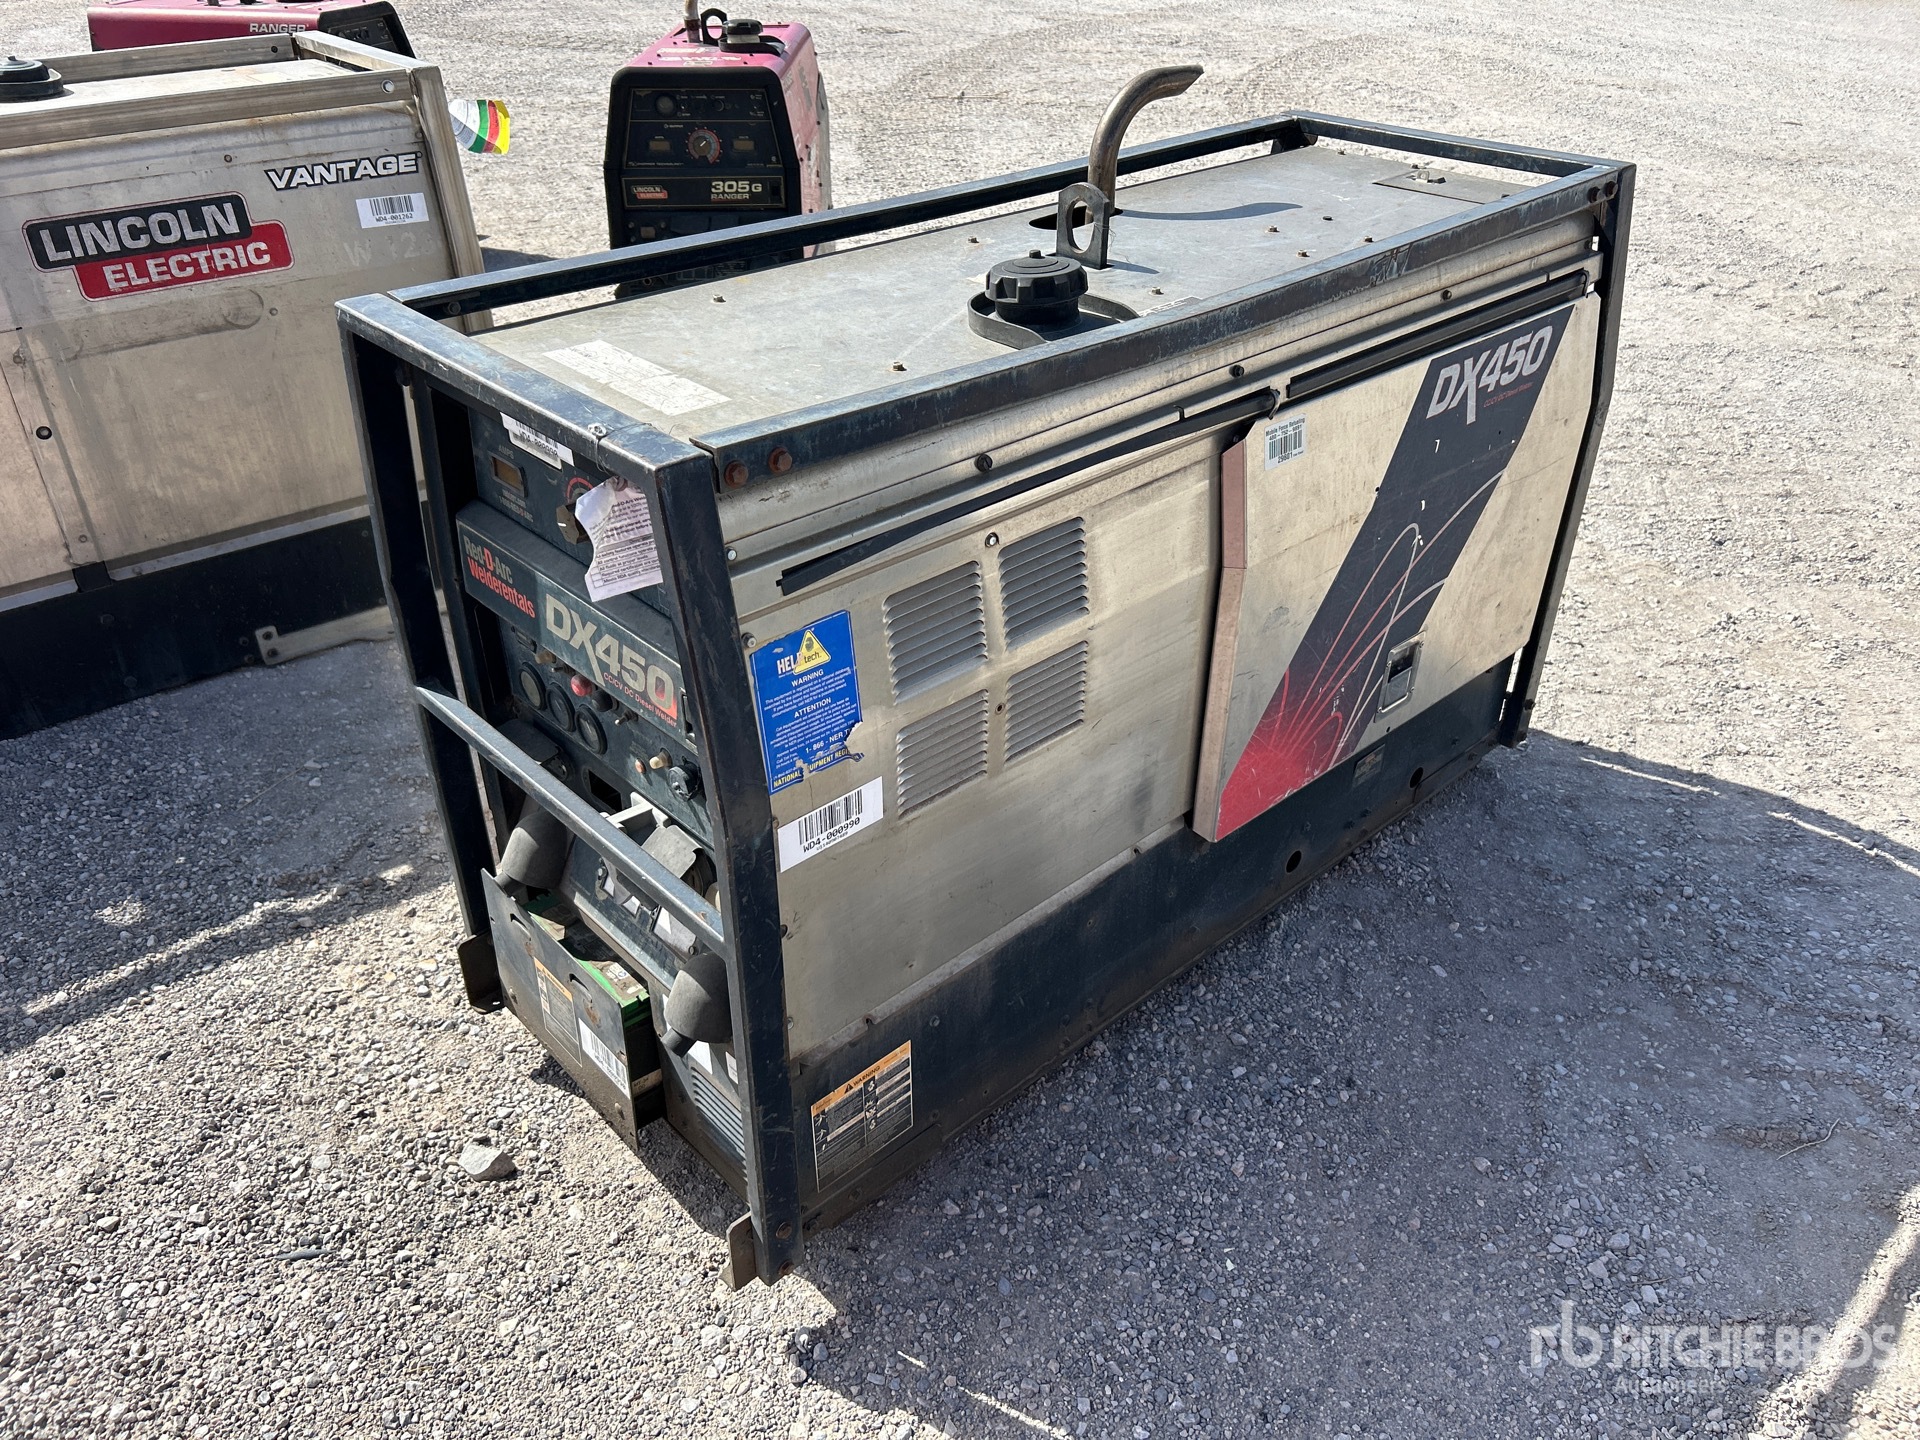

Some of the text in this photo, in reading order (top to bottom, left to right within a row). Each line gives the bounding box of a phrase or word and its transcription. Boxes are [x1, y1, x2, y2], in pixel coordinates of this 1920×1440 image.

[249, 22, 306, 33] RANGER
[266, 152, 418, 190] VANTAGE
[711, 180, 762, 193] 305 G
[39, 202, 240, 262] LINCOLN
[102, 241, 271, 291] ELECTRIC
[1425, 325, 1553, 425] DX450
[463, 534, 513, 585] Red-D-Arc
[467, 556, 536, 618] Welderentals
[545, 593, 675, 711] DX450
[791, 668, 824, 687] WARNING
[624, 687, 634, 698] DC
[634, 694, 655, 713] Diesel
[654, 706, 678, 728] Welder
[793, 697, 832, 719] ATTENTION
[829, 731, 844, 743] NER
[773, 769, 802, 788] NATIONAL
[808, 754, 834, 771] UIPMENT
[803, 816, 861, 853] WD4-000990
[852, 1065, 881, 1087] WARNING
